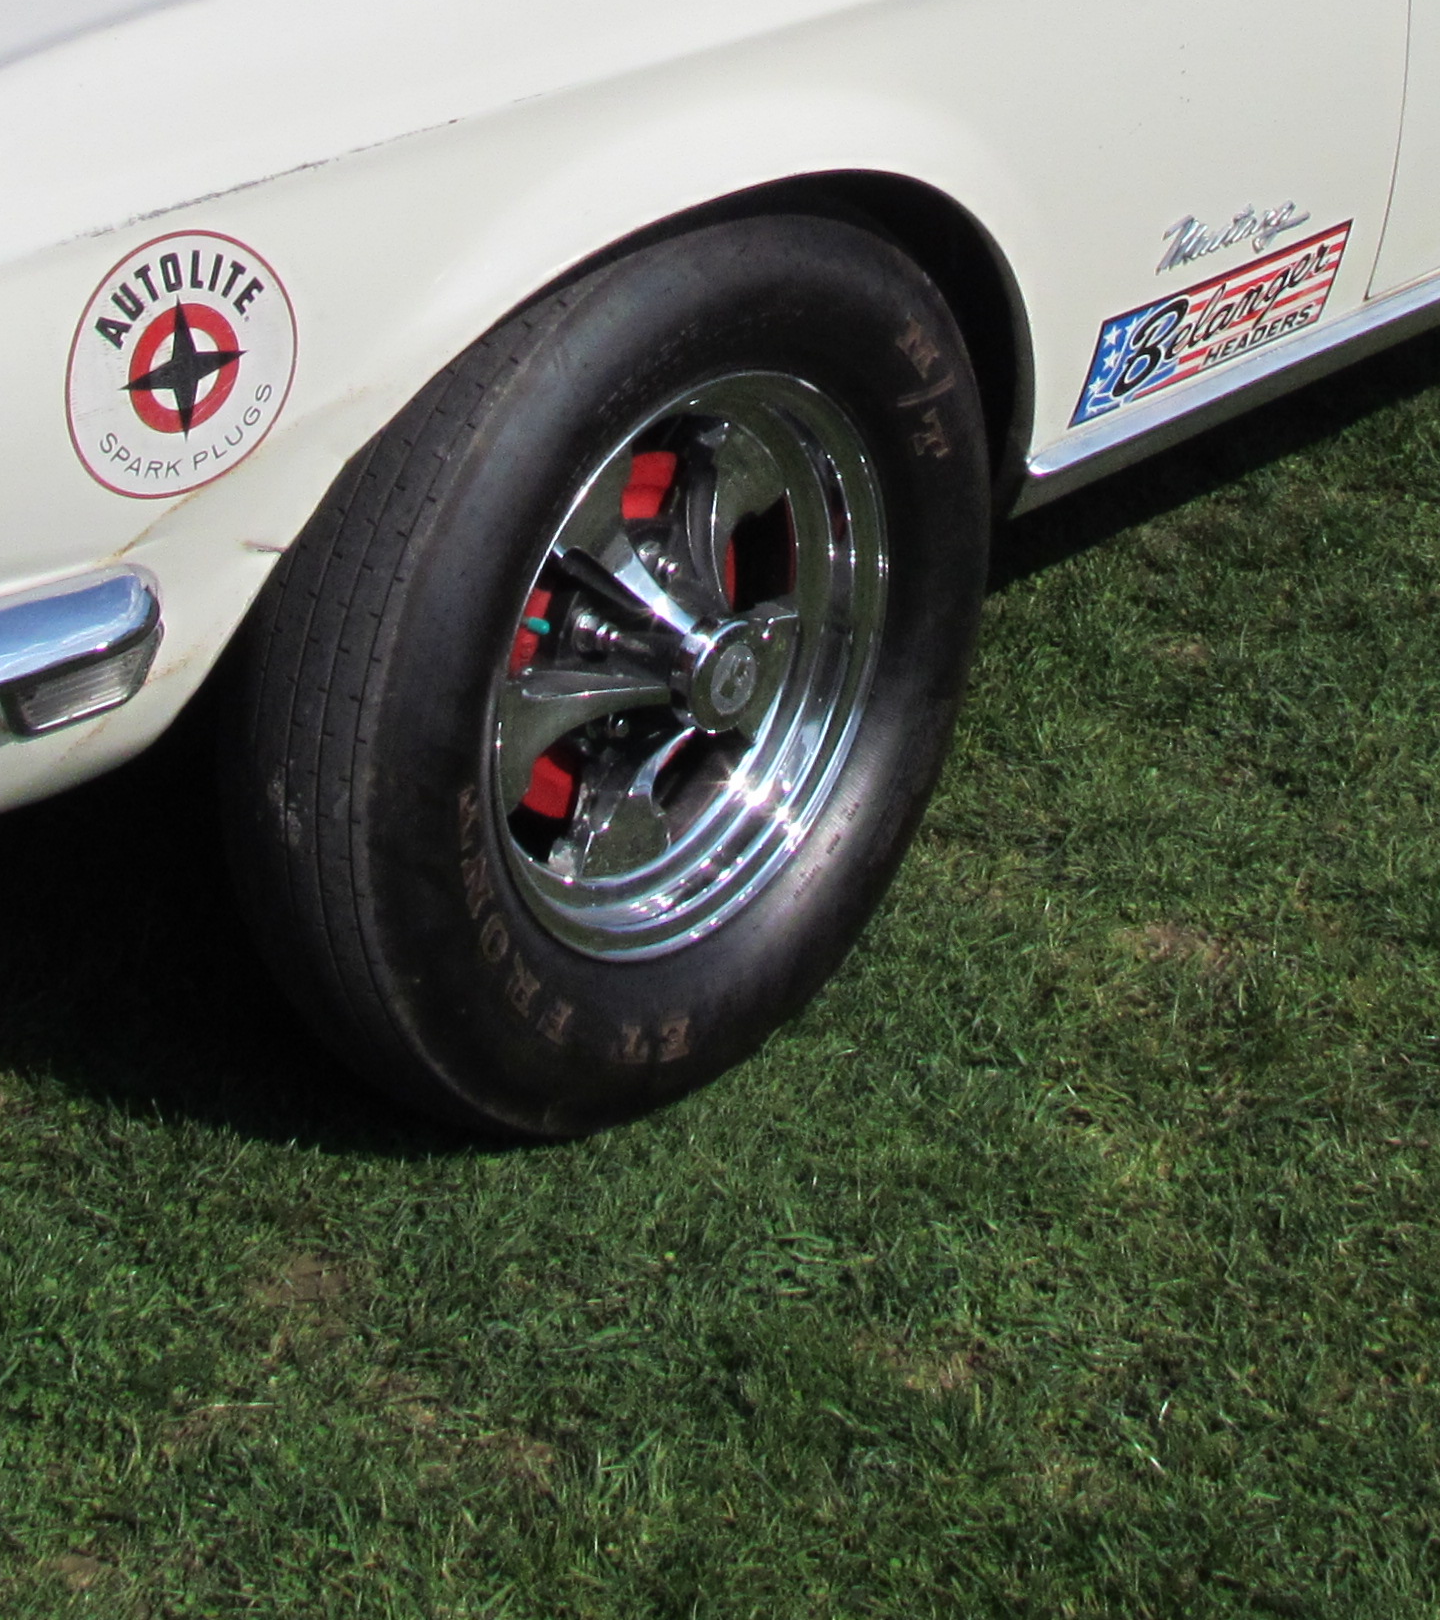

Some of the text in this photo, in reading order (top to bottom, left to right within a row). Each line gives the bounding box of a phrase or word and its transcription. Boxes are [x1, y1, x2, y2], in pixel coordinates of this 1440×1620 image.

[94, 248, 265, 350] AUTOLITE
[1110, 242, 1330, 399] Belanger
[1205, 302, 1315, 364] HEADERS
[99, 383, 274, 479] SPARK PLUGS
